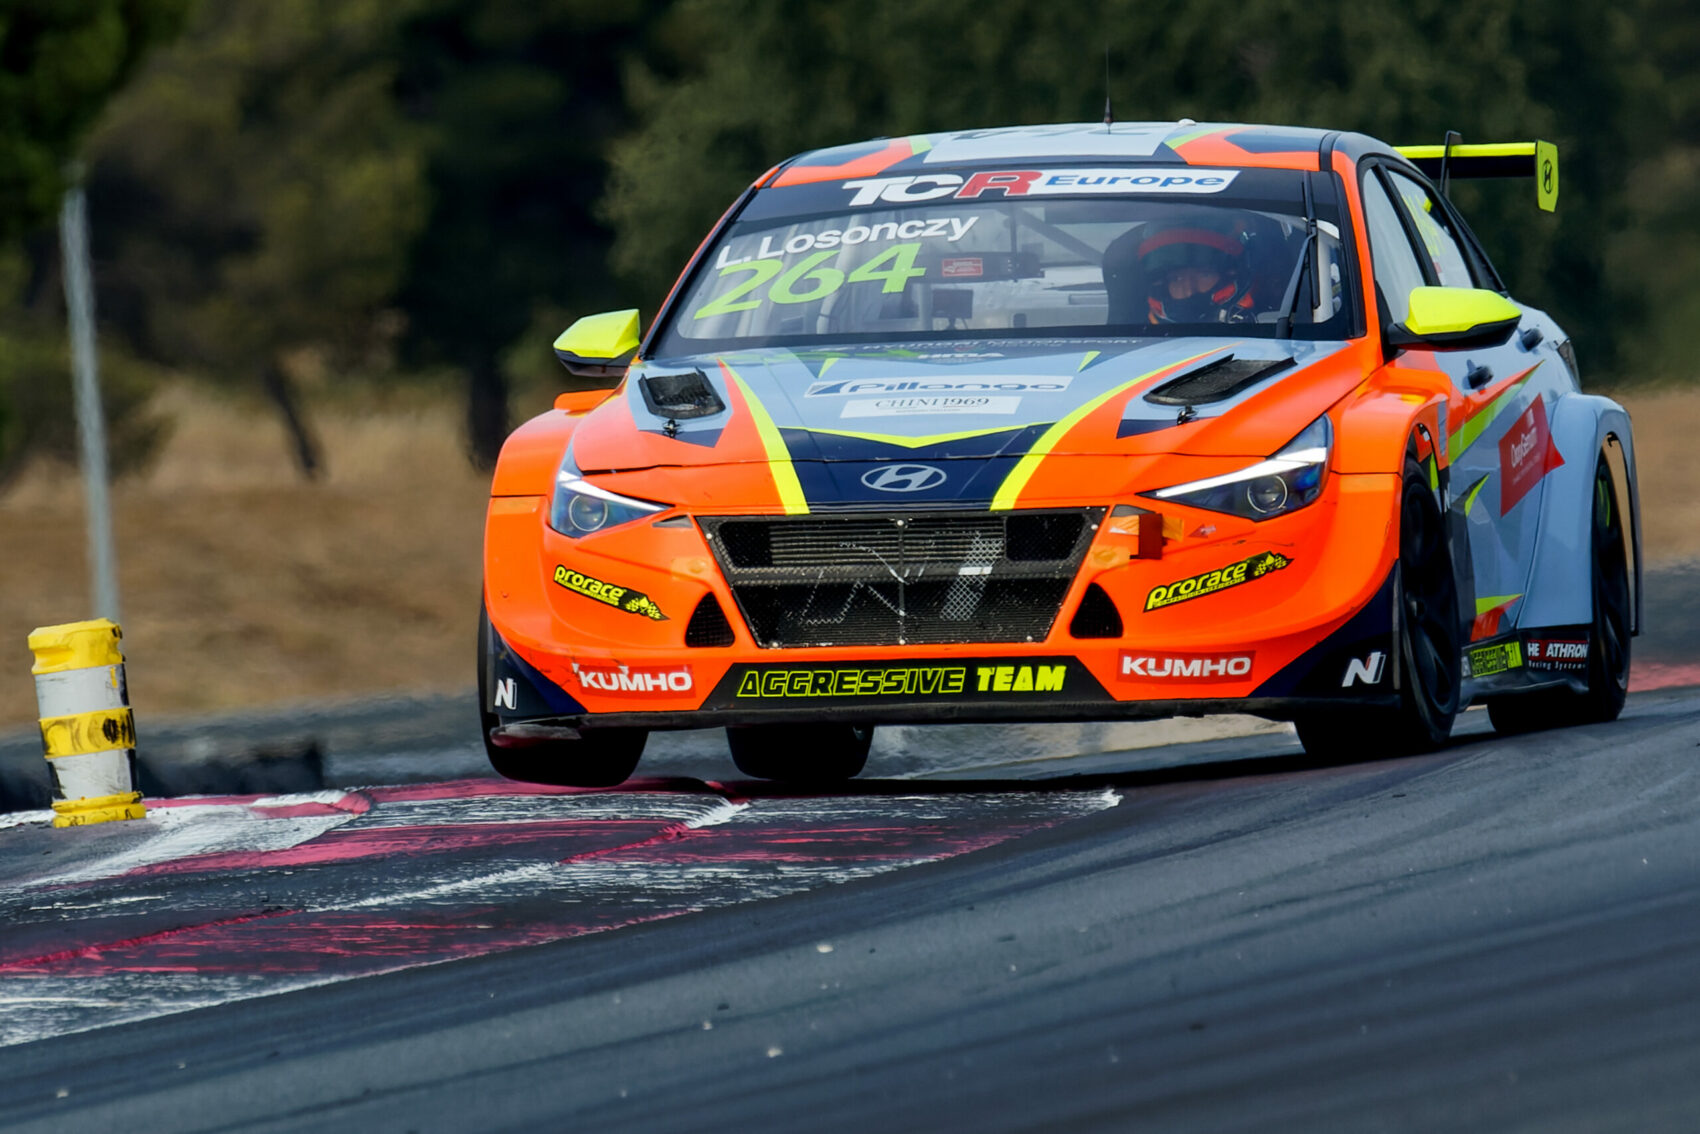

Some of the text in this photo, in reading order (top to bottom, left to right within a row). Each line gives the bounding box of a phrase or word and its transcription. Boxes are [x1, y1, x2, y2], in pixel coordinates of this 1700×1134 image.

[841, 170, 1225, 206] TCR Europe
[694, 242, 927, 320] 264
[554, 566, 624, 602] prorace
[1147, 562, 1248, 610] prorace
[579, 670, 692, 692] KUMHO
[737, 664, 1066, 697] AGGRESSIVE TEAM
[1122, 656, 1252, 677] KUMHO
